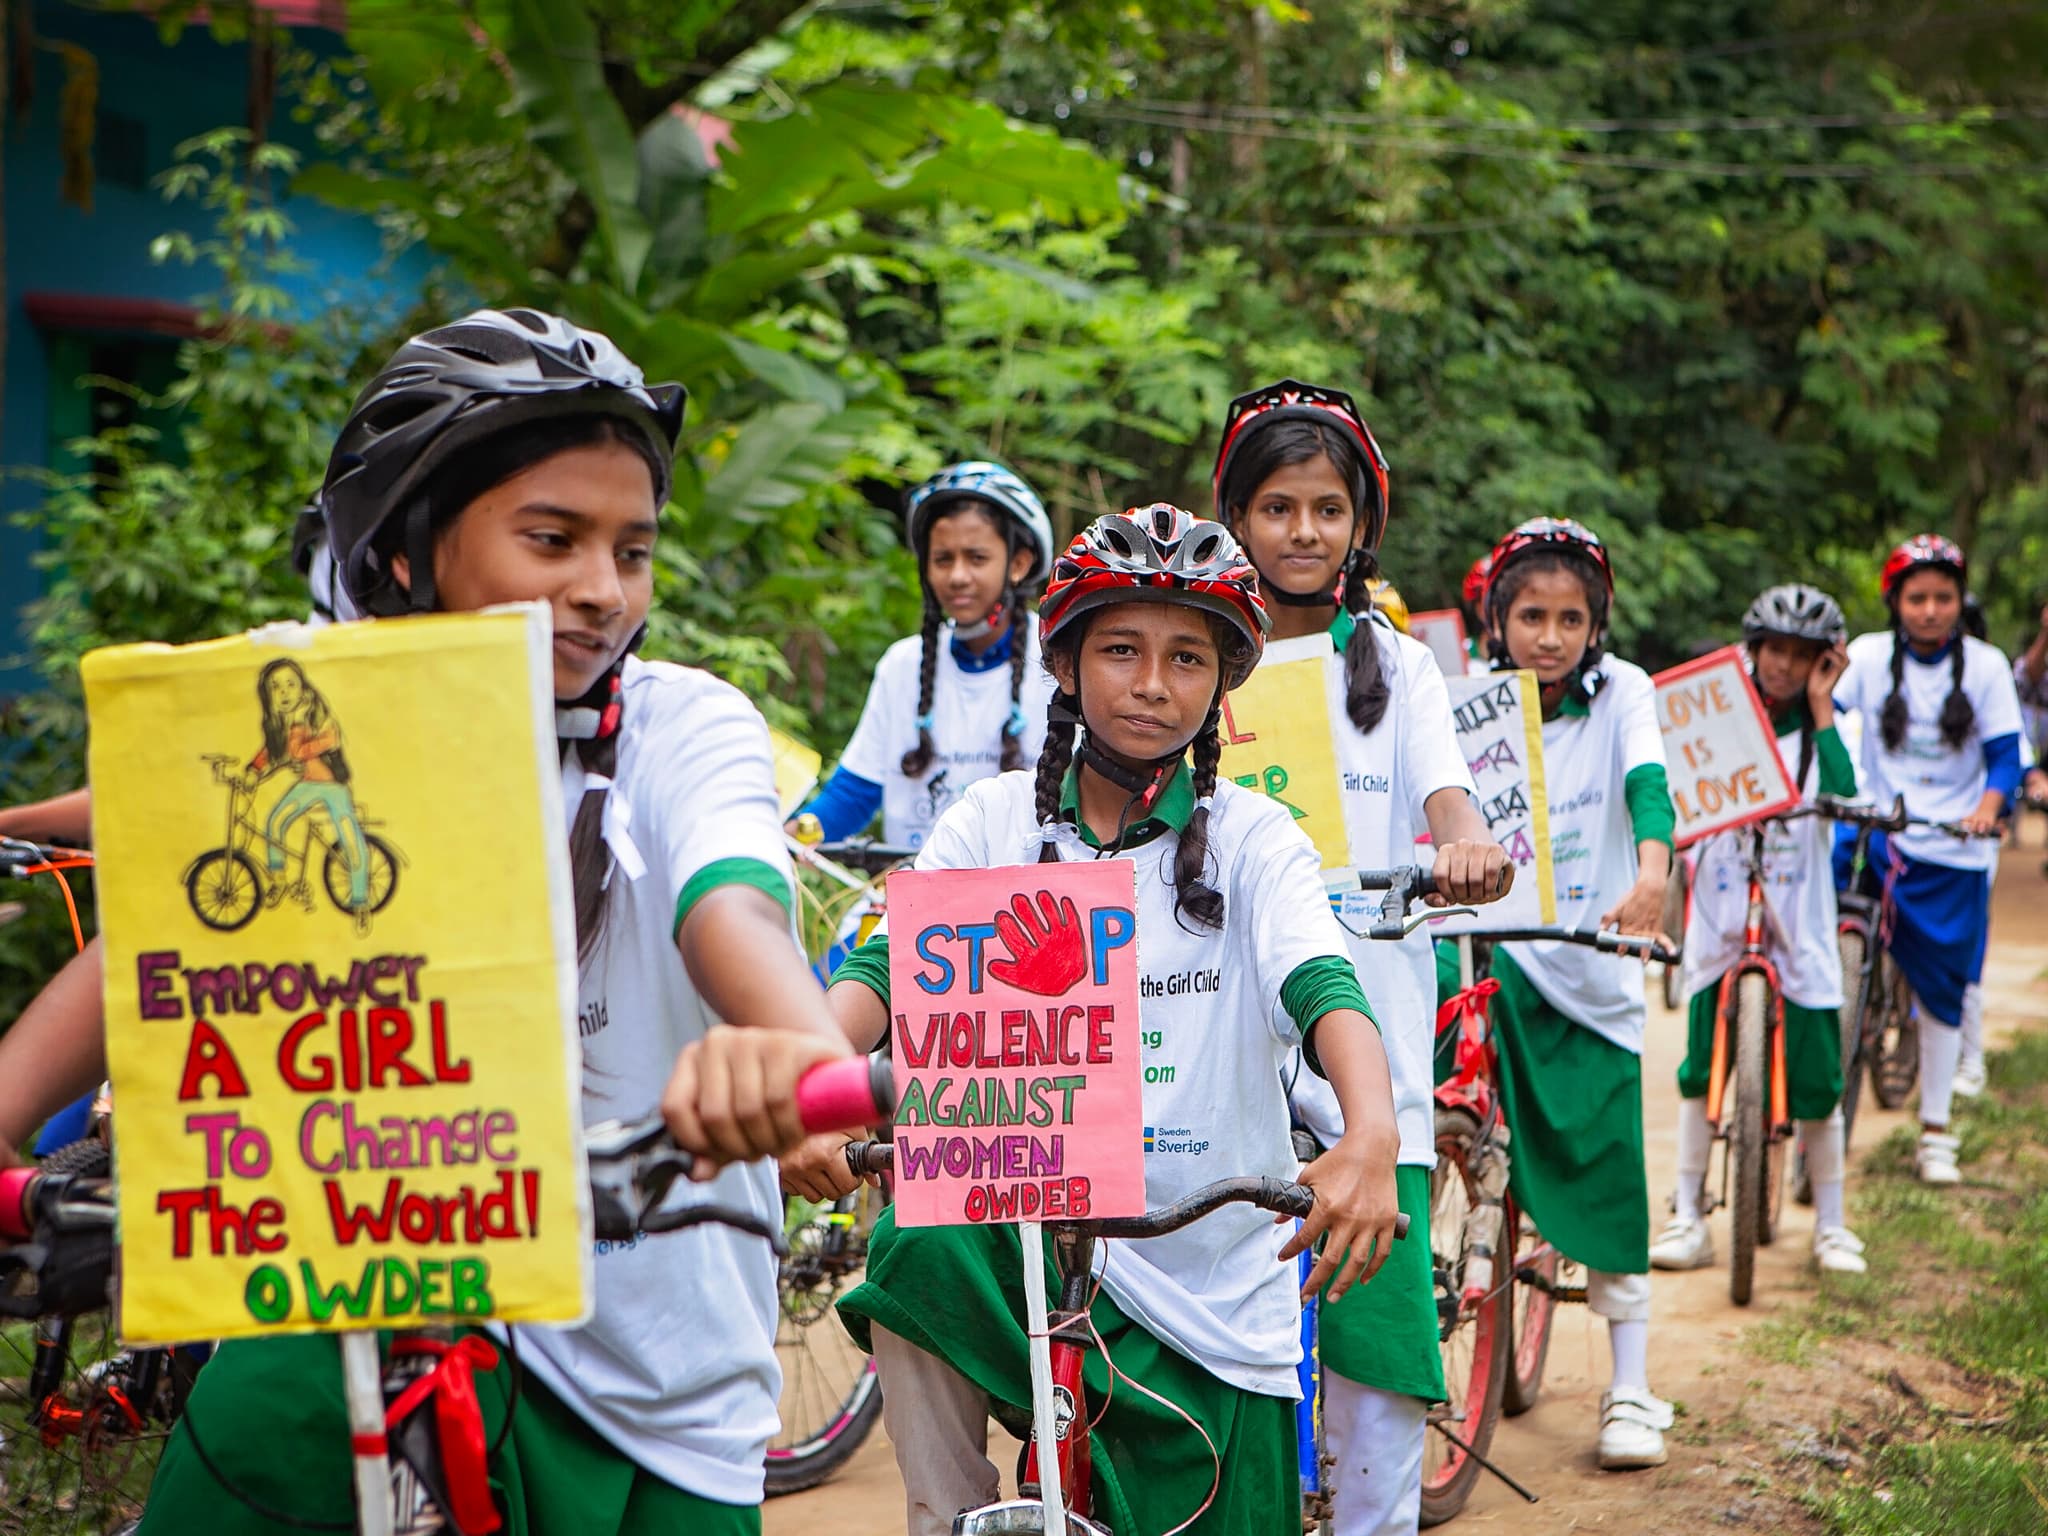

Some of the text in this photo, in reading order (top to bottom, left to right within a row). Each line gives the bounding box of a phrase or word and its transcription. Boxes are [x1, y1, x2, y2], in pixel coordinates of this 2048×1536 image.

[1682, 736, 1713, 770] IS
[1363, 775, 1388, 793] Child
[1673, 763, 1766, 824] LOVE
[138, 950, 427, 1019] Empower
[1140, 974, 1163, 997] the
[1167, 971, 1191, 995] Girl
[579, 996, 608, 1037] hild
[896, 1005, 1114, 1069] VIOLENCE
[178, 999, 472, 1101] A GIRL
[894, 1075, 1086, 1127] AGAINST
[186, 1099, 518, 1179] To Change
[1158, 1127, 1191, 1136] Sweden
[1158, 1139, 1209, 1155] Sverige
[897, 1134, 1064, 1180] WOMEN
[157, 1184, 288, 1258] The
[964, 1177, 1091, 1222] OWDEB
[245, 1256, 494, 1323] OWDEB
